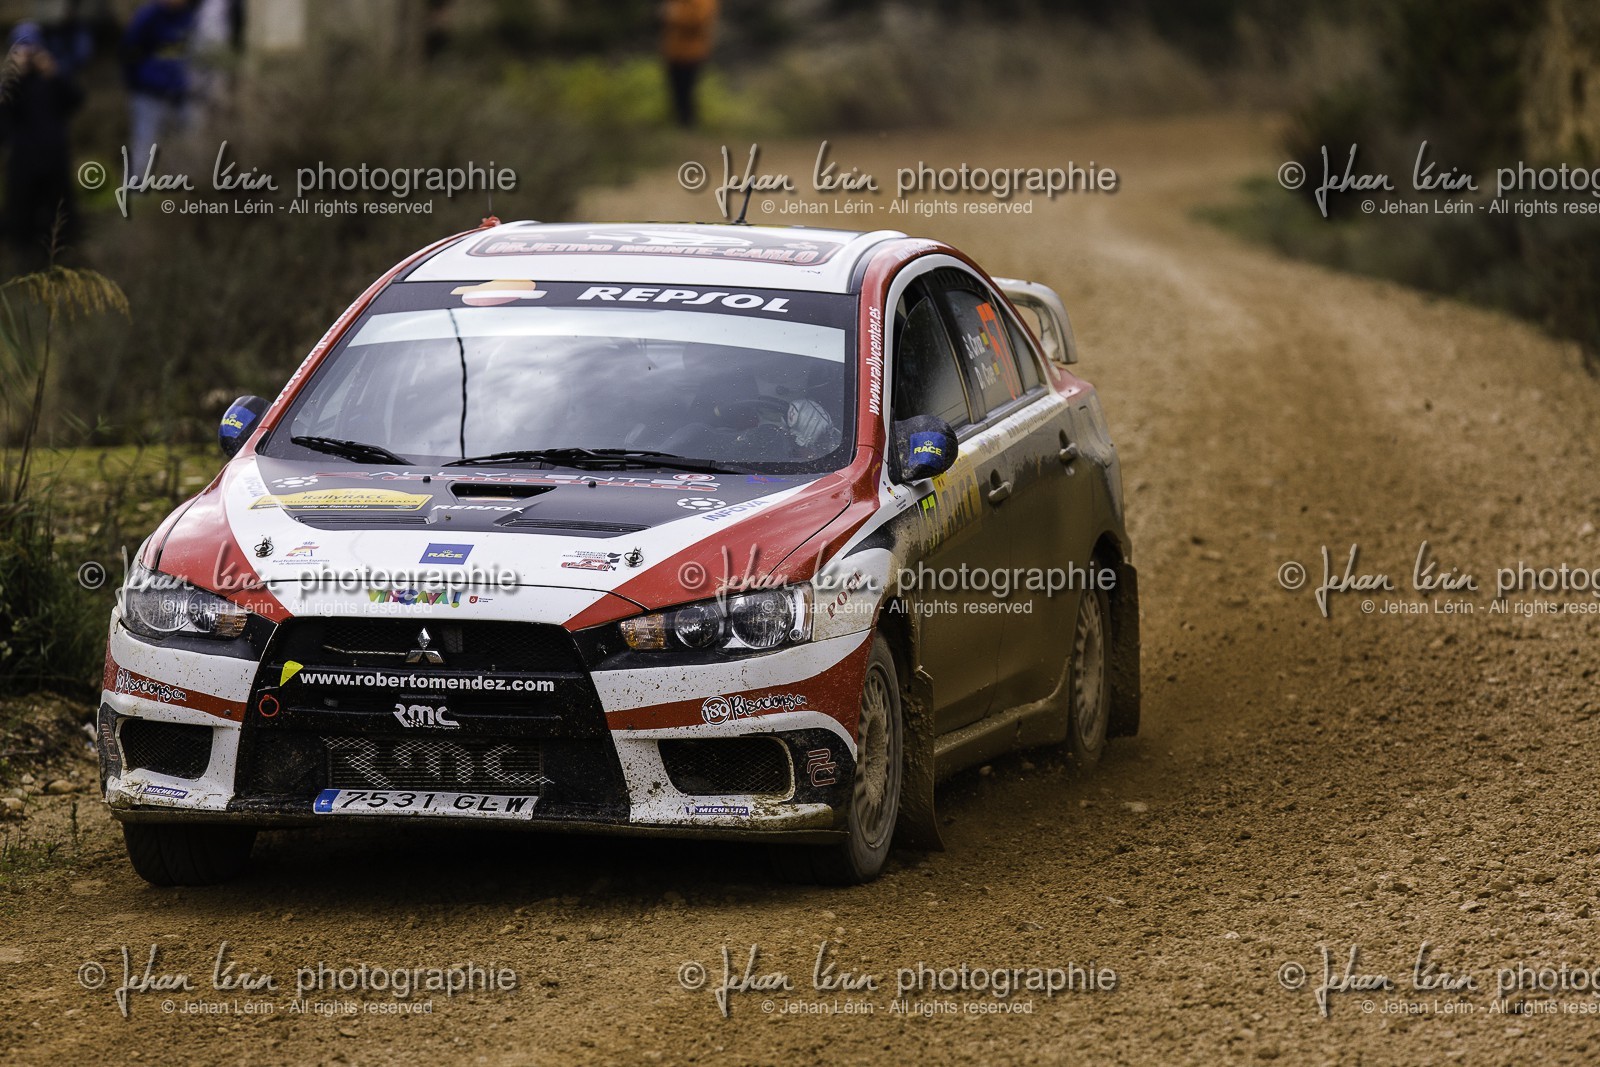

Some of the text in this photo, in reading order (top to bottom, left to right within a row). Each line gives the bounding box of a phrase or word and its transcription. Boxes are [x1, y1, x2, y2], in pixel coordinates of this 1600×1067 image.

[487, 241, 819, 264] OBJETIVO MONTE-CARLO
[576, 286, 790, 313] REPSOL
[866, 307, 884, 416] www.rallycenter.es
[913, 446, 942, 456] RACE
[432, 504, 524, 514] REPSOL
[701, 499, 768, 522] INFOVA
[427, 552, 464, 560] RACE
[299, 672, 555, 692] www.robertomendez.com
[702, 697, 731, 725] 180
[146, 786, 187, 798] MICHELIN
[339, 791, 530, 812] 7531 GLW
[699, 807, 748, 816] MICHELIN
